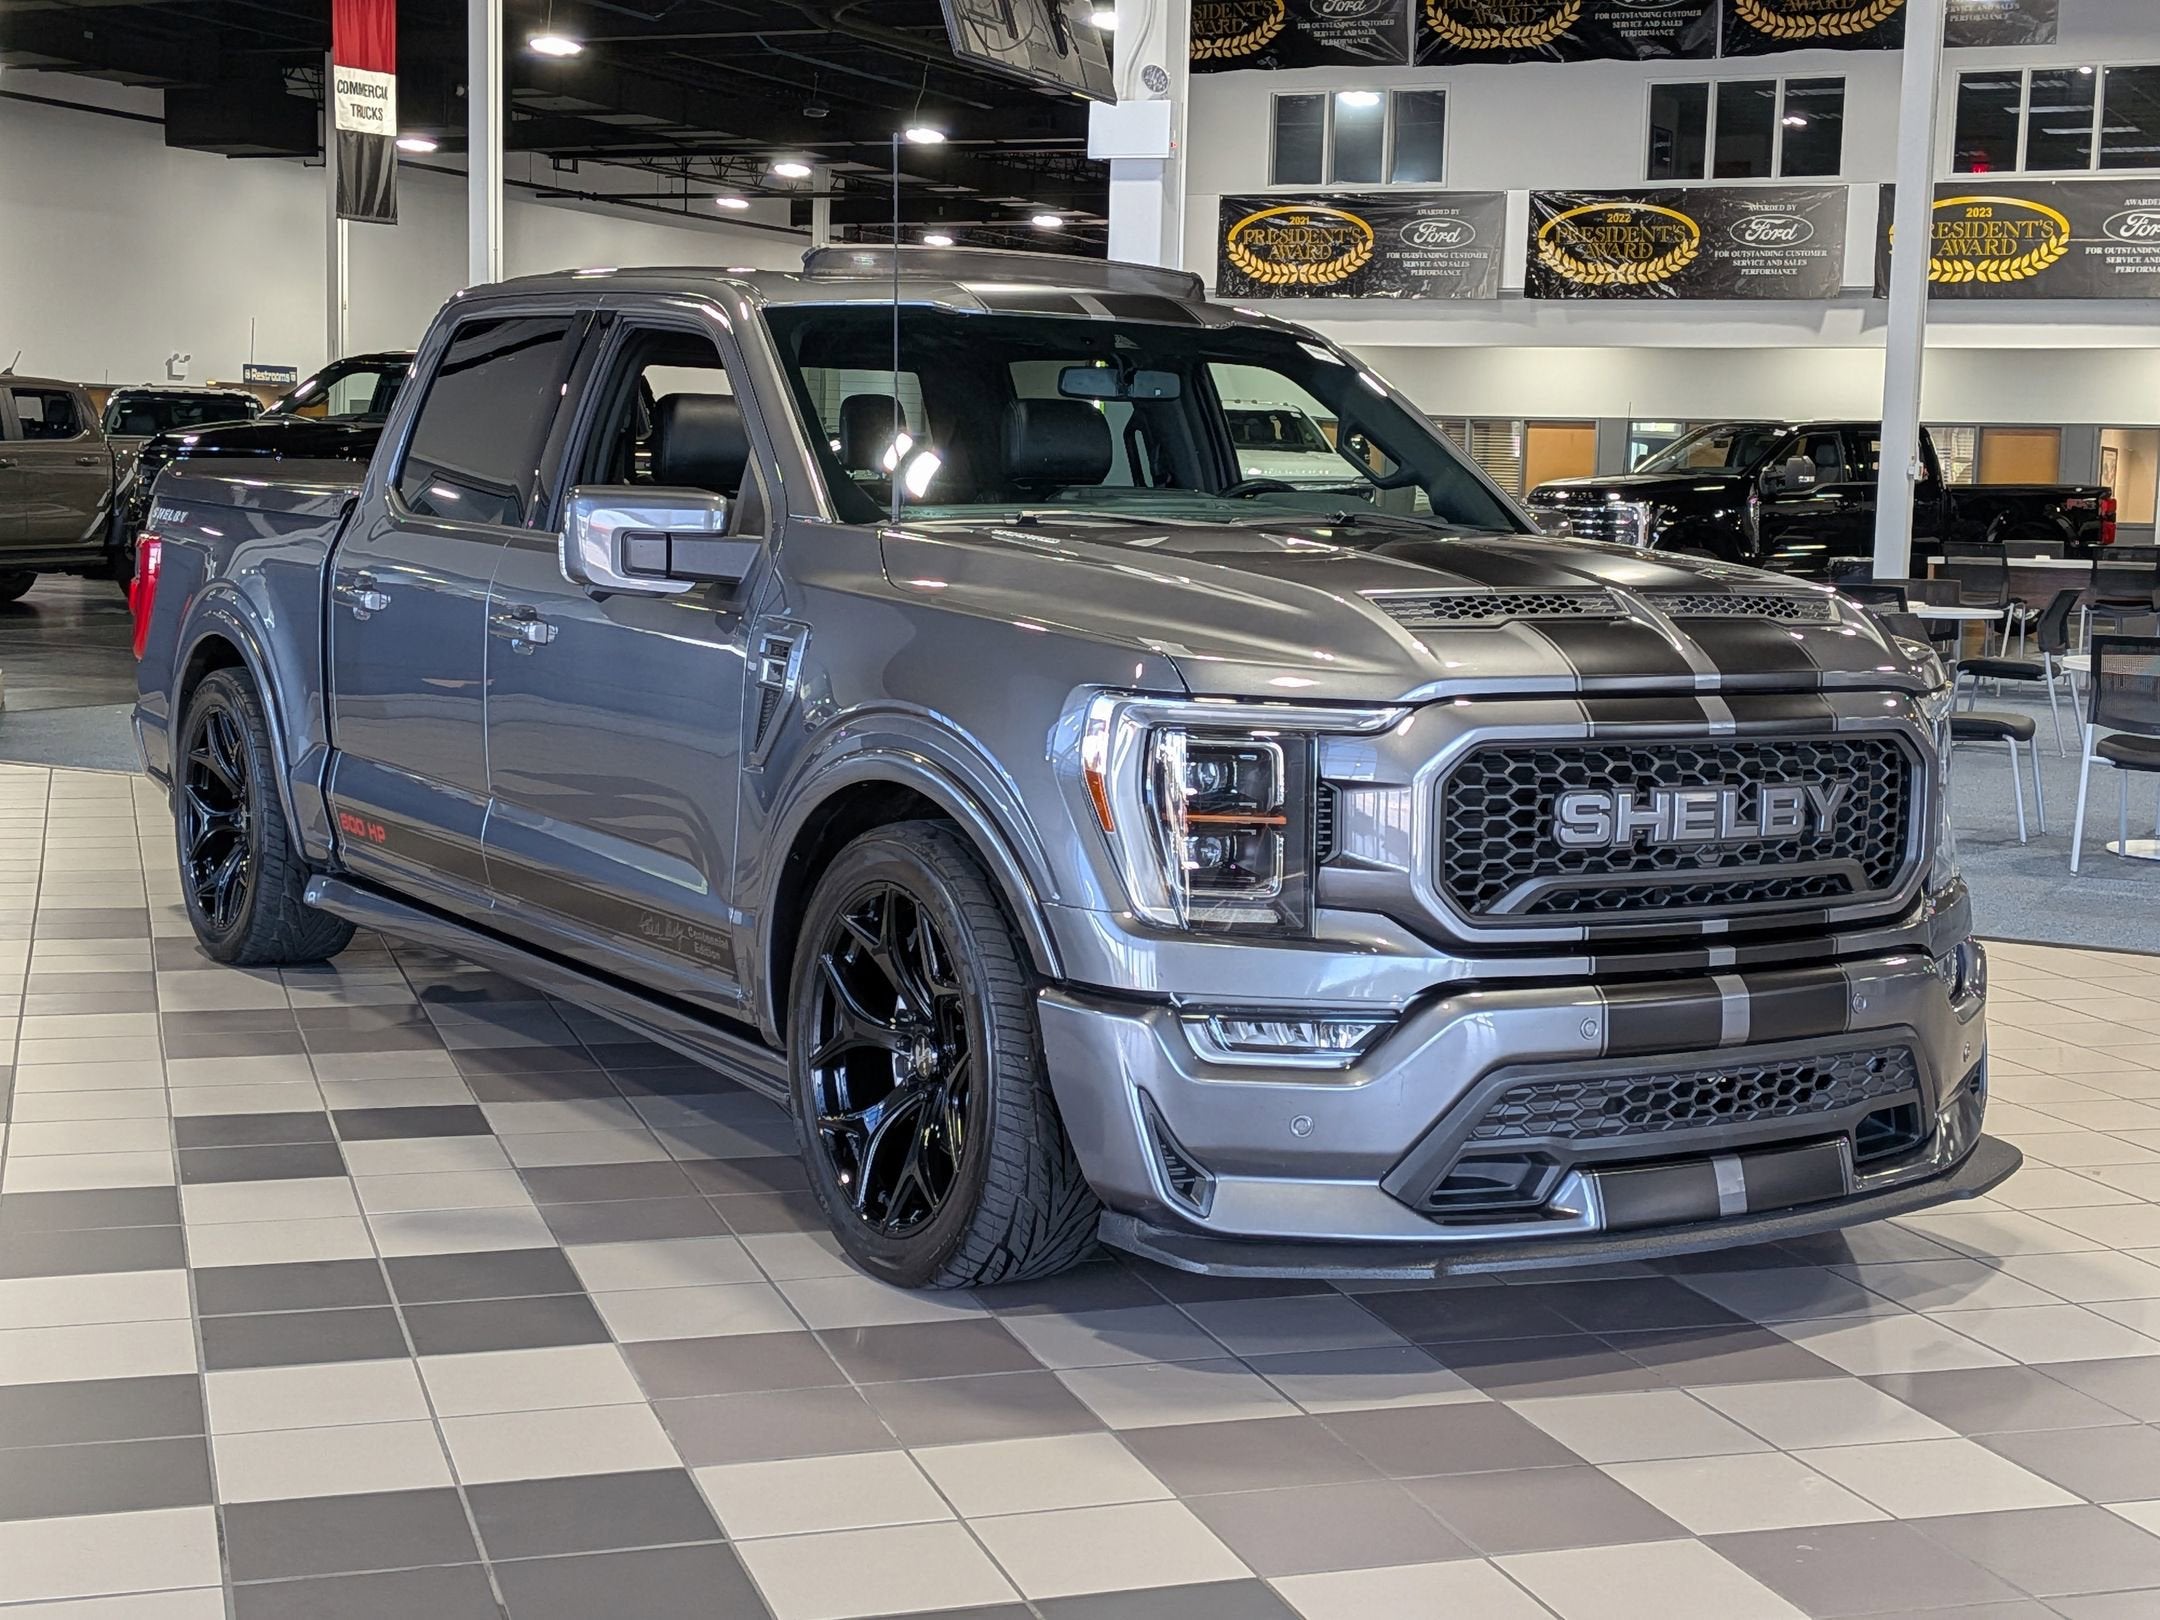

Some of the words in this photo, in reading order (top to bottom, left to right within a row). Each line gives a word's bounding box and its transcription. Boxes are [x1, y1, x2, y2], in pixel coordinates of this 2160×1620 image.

[1192, 0, 1274, 20] SIDENT'S
[1323, 0, 1367, 13] Ford
[1595, 12, 1610, 20] FOR
[1611, 11, 1661, 19] OUTSTANDING
[1663, 9, 1702, 17] CUSTOMER
[1192, 18, 1245, 34] WARD
[1613, 20, 1642, 28] SERVICE
[1661, 19, 1684, 27] SALES
[1620, 28, 1675, 38] PERFORMANCE
[350, 103, 383, 121] TRUCKS
[1748, 204, 1785, 212] AWARDED
[2124, 198, 2160, 206] AWARDE
[1606, 213, 1632, 223] 2022
[1965, 207, 1993, 218] 2023
[1289, 215, 1310, 225] 2021
[2120, 213, 2160, 237] For
[1243, 227, 1362, 246] PRESIDENT'S
[1413, 221, 1462, 244] Ford
[1555, 225, 1687, 243] PRESIDENT'S
[1744, 218, 1799, 241] Ford
[1268, 244, 1332, 260] AWARD
[1581, 242, 1654, 259] AWARD
[1714, 250, 1730, 258] FOR
[1731, 250, 1783, 258] OUTSTANDING
[1936, 238, 2017, 256] AWARD
[1402, 260, 1431, 268] SERVICE
[1433, 260, 1448, 268] AND
[1732, 259, 1765, 267] SERVICE
[1766, 259, 1783, 267] AND
[2115, 266, 2160, 274] PERFORMA
[1410, 269, 1462, 277] PERFORMANCE
[1740, 268, 1798, 276] PERFORMANCE
[251, 368, 290, 383] Restrooms
[152, 507, 189, 523] SHELBY
[1555, 777, 1850, 848] SHELBY
[367, 821, 385, 844] HP
